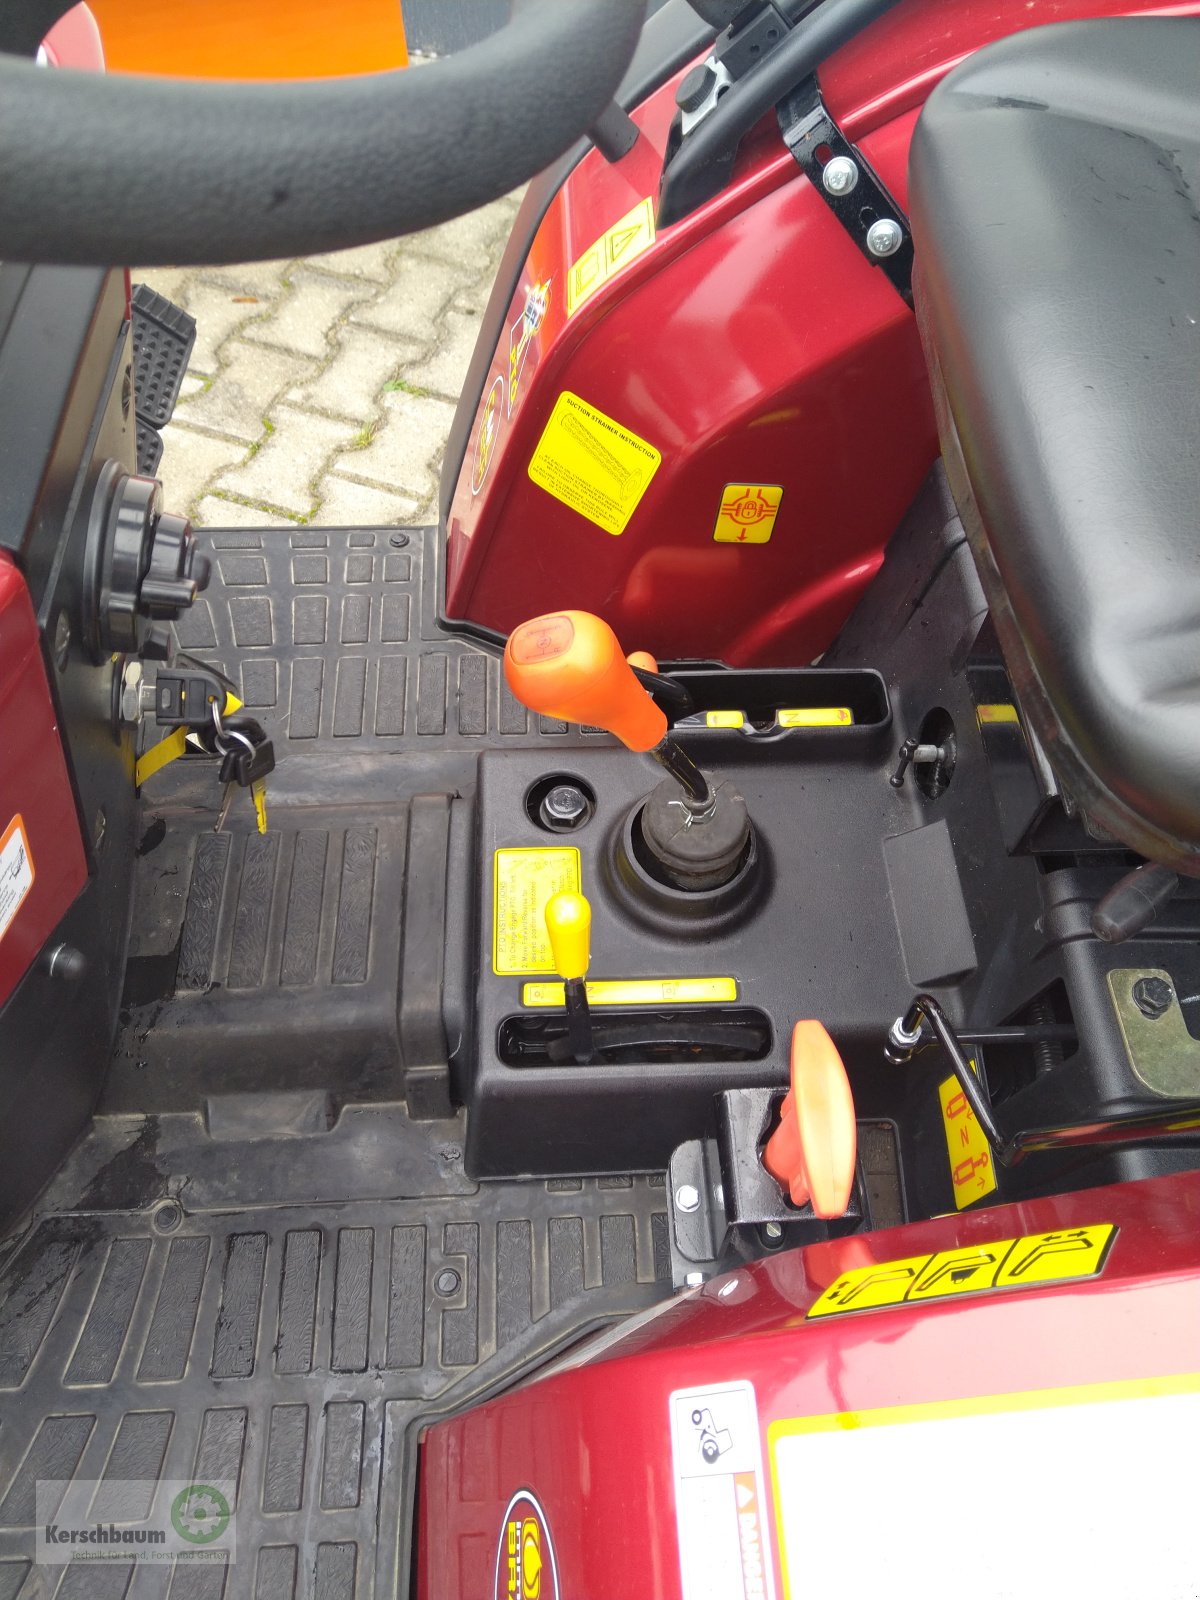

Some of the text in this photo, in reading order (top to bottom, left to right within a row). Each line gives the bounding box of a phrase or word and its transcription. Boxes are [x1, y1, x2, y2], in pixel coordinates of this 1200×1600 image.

[566, 398, 656, 460] SUCTION STRAINER INSTRUCTION
[960, 1126, 970, 1147] N
[508, 1522, 516, 1600] BR
